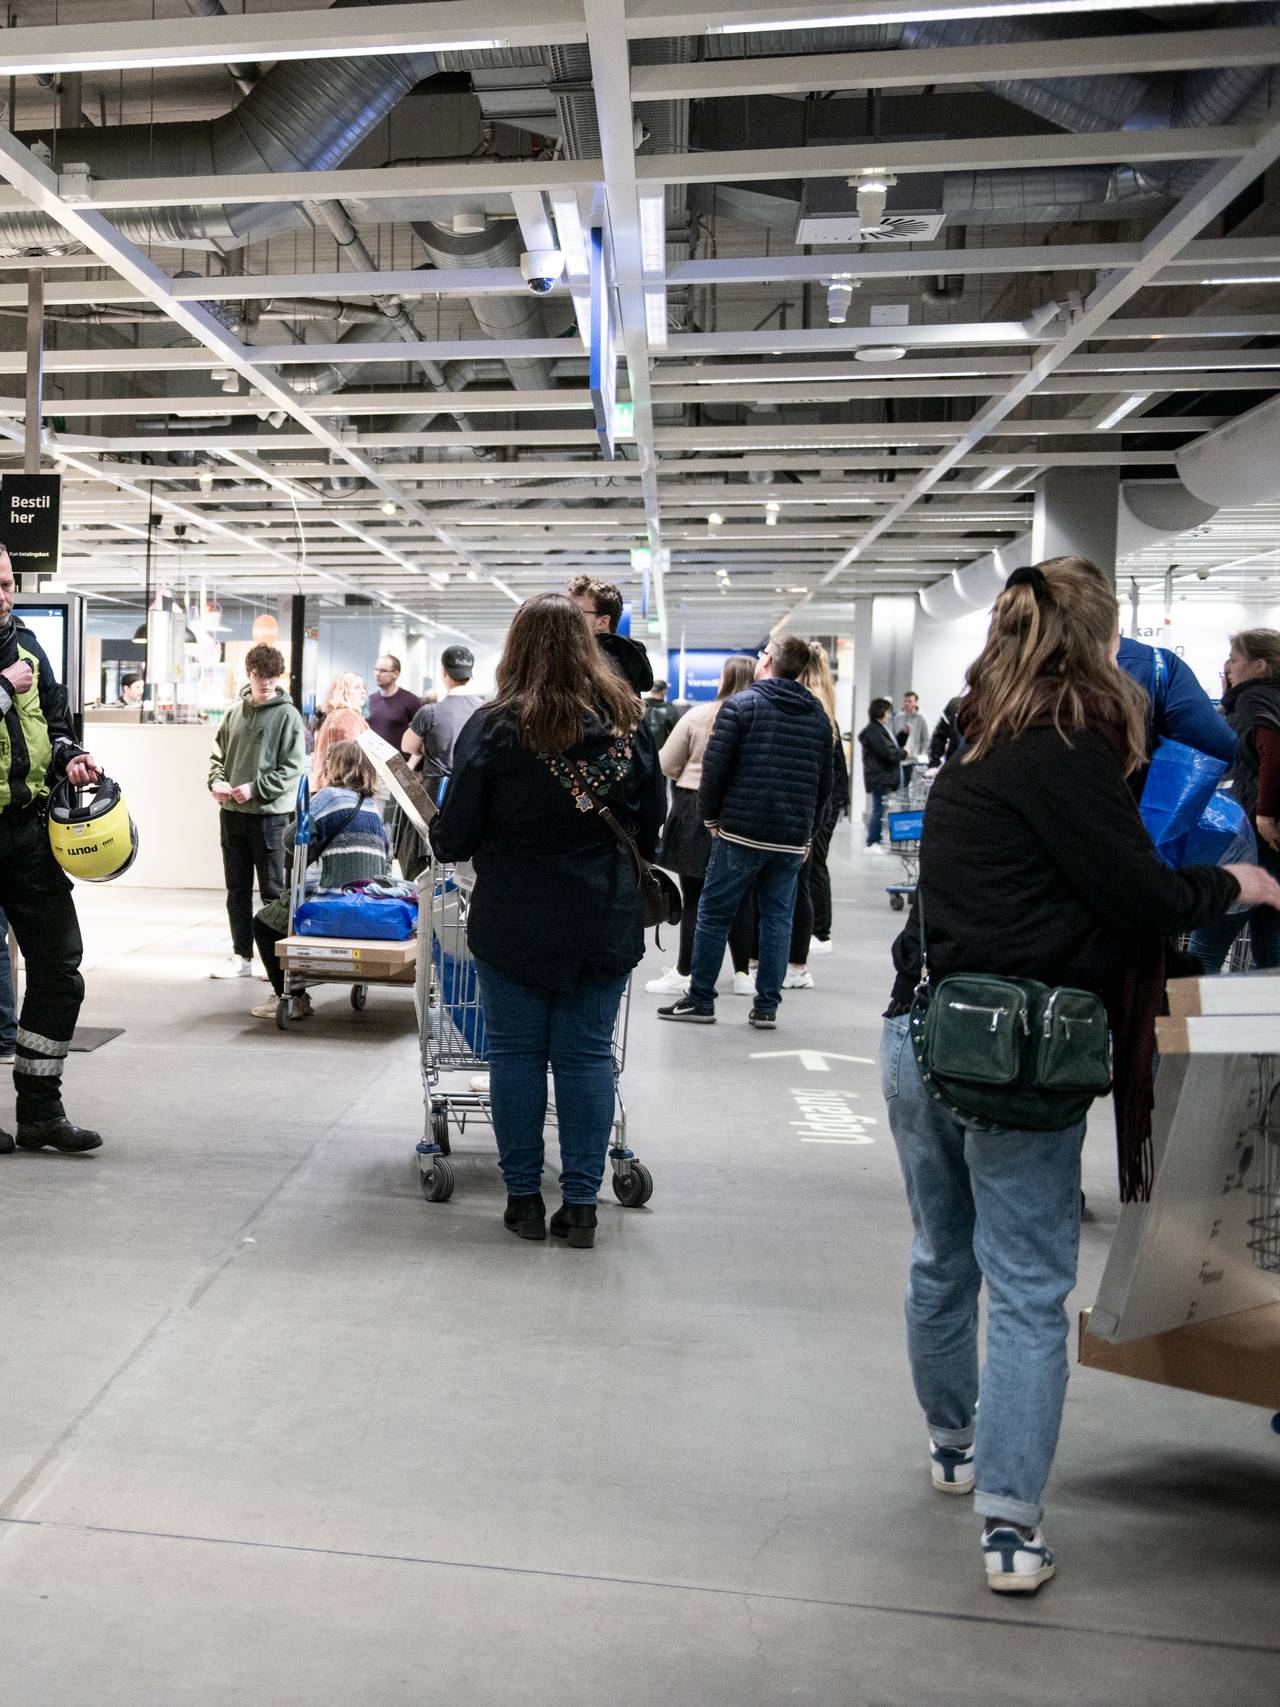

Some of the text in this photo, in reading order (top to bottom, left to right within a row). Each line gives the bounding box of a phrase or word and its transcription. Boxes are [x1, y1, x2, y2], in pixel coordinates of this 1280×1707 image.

[11, 495, 50, 509] Bestil
[10, 511, 35, 524] her
[67, 845, 99, 856] POLITI
[788, 1087, 877, 1145] Udgang
